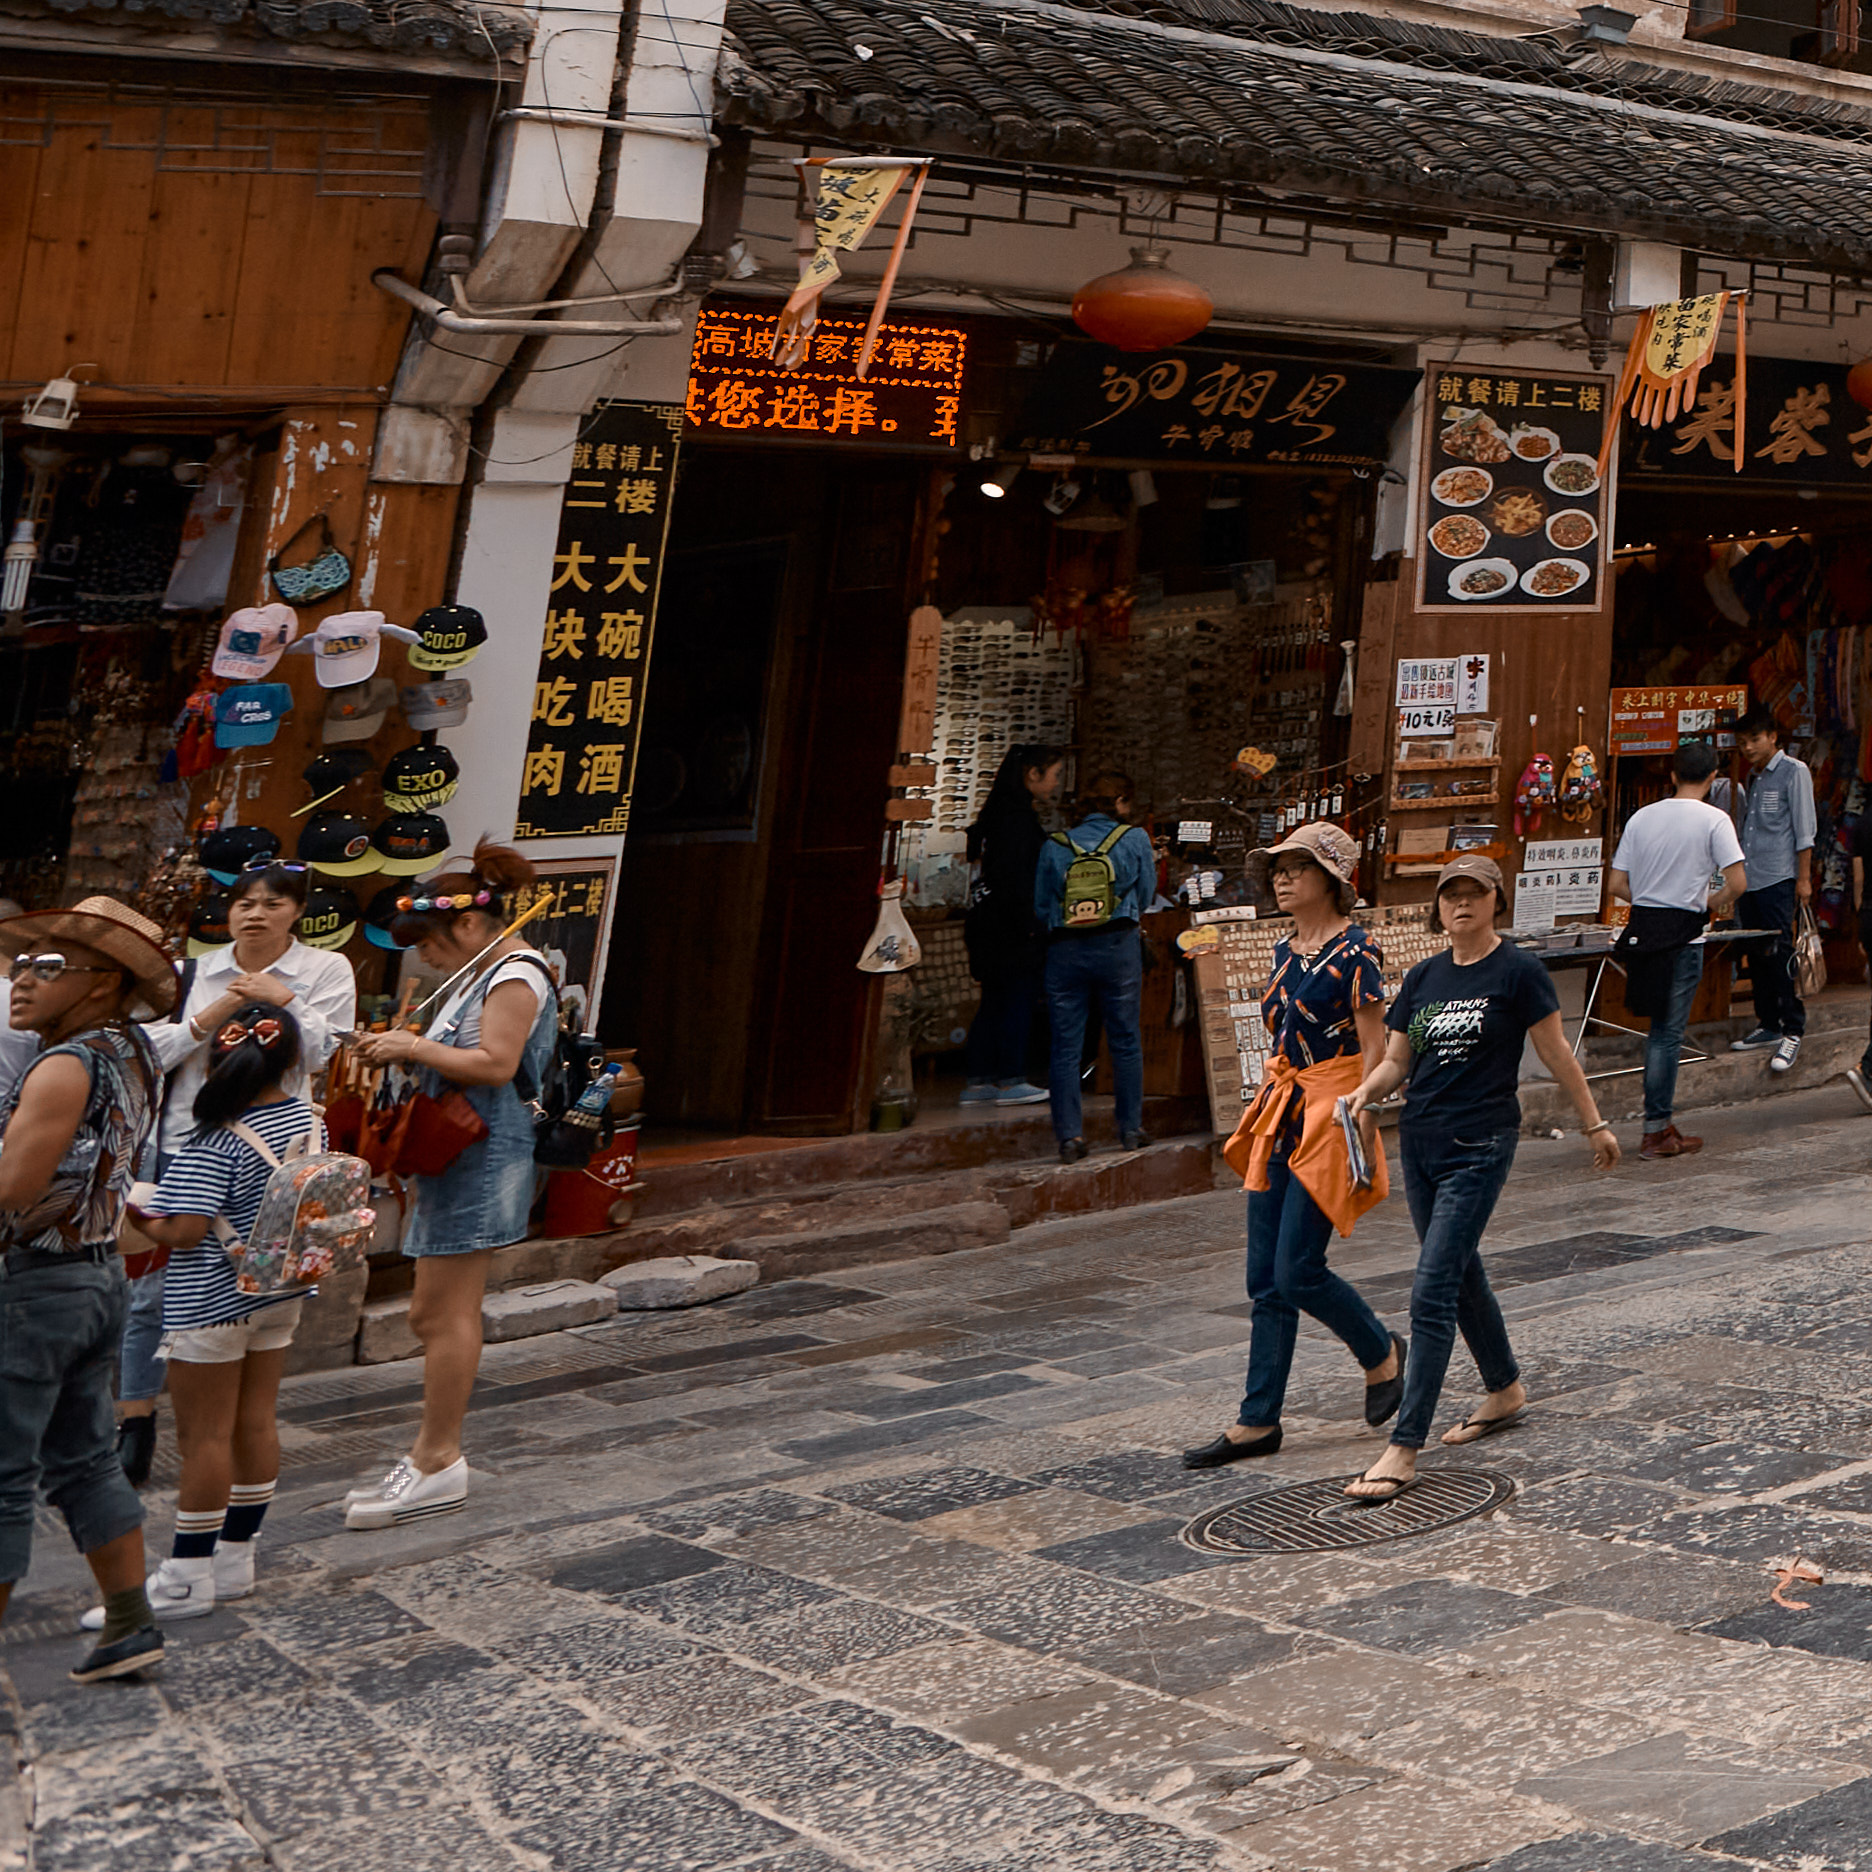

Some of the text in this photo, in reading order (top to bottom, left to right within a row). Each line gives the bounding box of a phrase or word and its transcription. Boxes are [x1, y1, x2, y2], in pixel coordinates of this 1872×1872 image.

[1437, 375, 1602, 412] 就餐请上二楼
[572, 442, 664, 472] 就餐请上
[565, 478, 658, 514] 二楼
[423, 631, 468, 650] COCO
[396, 768, 447, 793] EXO
[300, 912, 341, 935] OCO
[1442, 997, 1490, 1013] ATHENS
